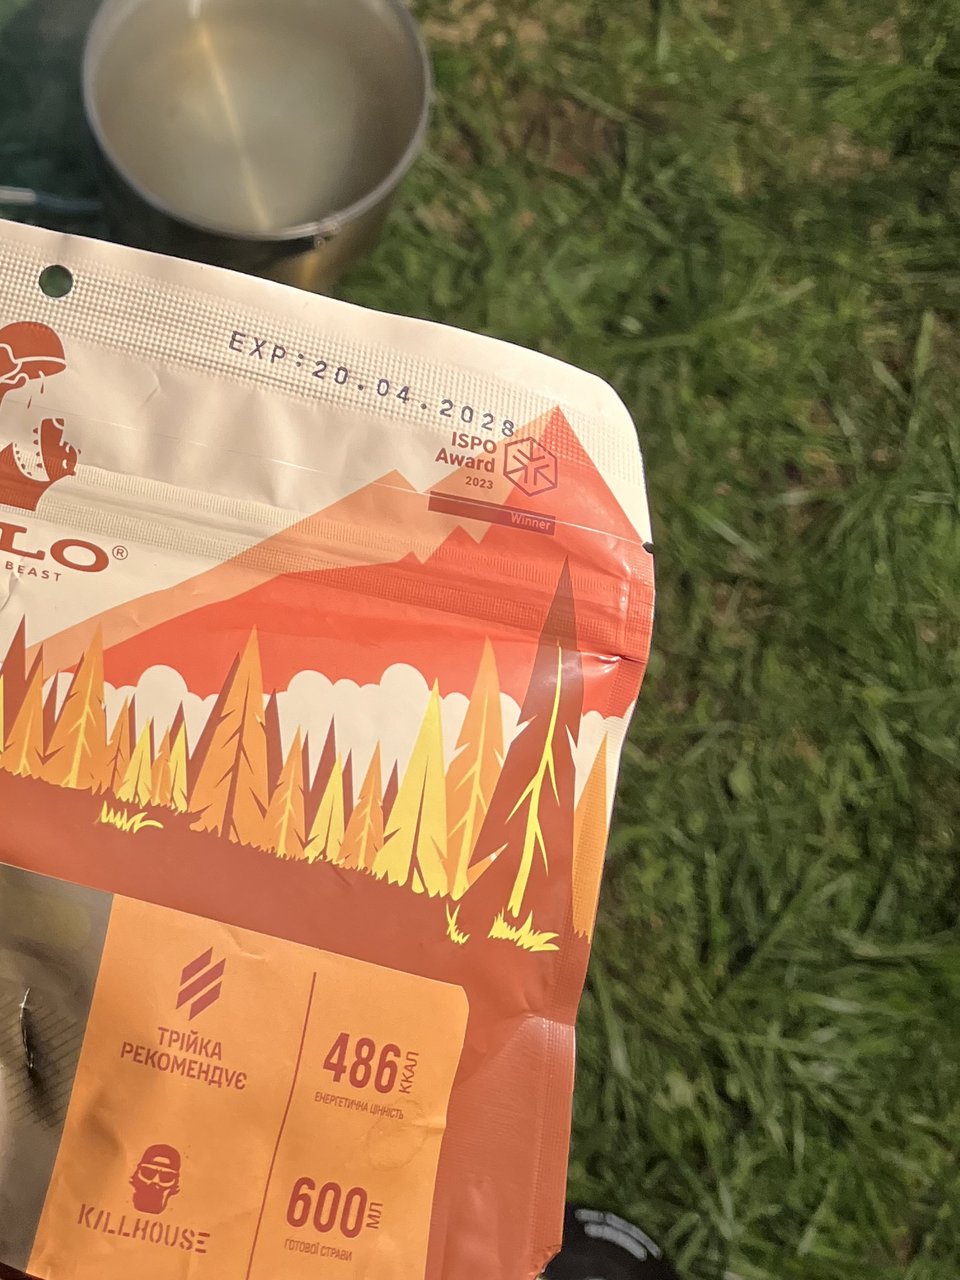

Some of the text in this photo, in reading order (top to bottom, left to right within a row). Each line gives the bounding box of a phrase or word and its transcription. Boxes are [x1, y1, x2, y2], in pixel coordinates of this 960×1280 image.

[451, 431, 497, 454] ISPO
[434, 447, 496, 473] Award
[465, 476, 493, 490] 2023
[510, 511, 551, 530] Winner
[4, 560, 62, 582] BEAST
[156, 1026, 223, 1061] ТРІЙКА
[120, 1041, 248, 1090] РЕКОМЕНДУЄ
[322, 1032, 419, 1094] 486 ККАЛ
[314, 1091, 404, 1120] ЕНЕРГЕТИЧНА ЦІННІСТЬ
[286, 1176, 384, 1239] 600 МЛ
[77, 1203, 211, 1255] KILLHOUSE
[284, 1238, 353, 1262] ГОТОВОЇ СТРАВИ
